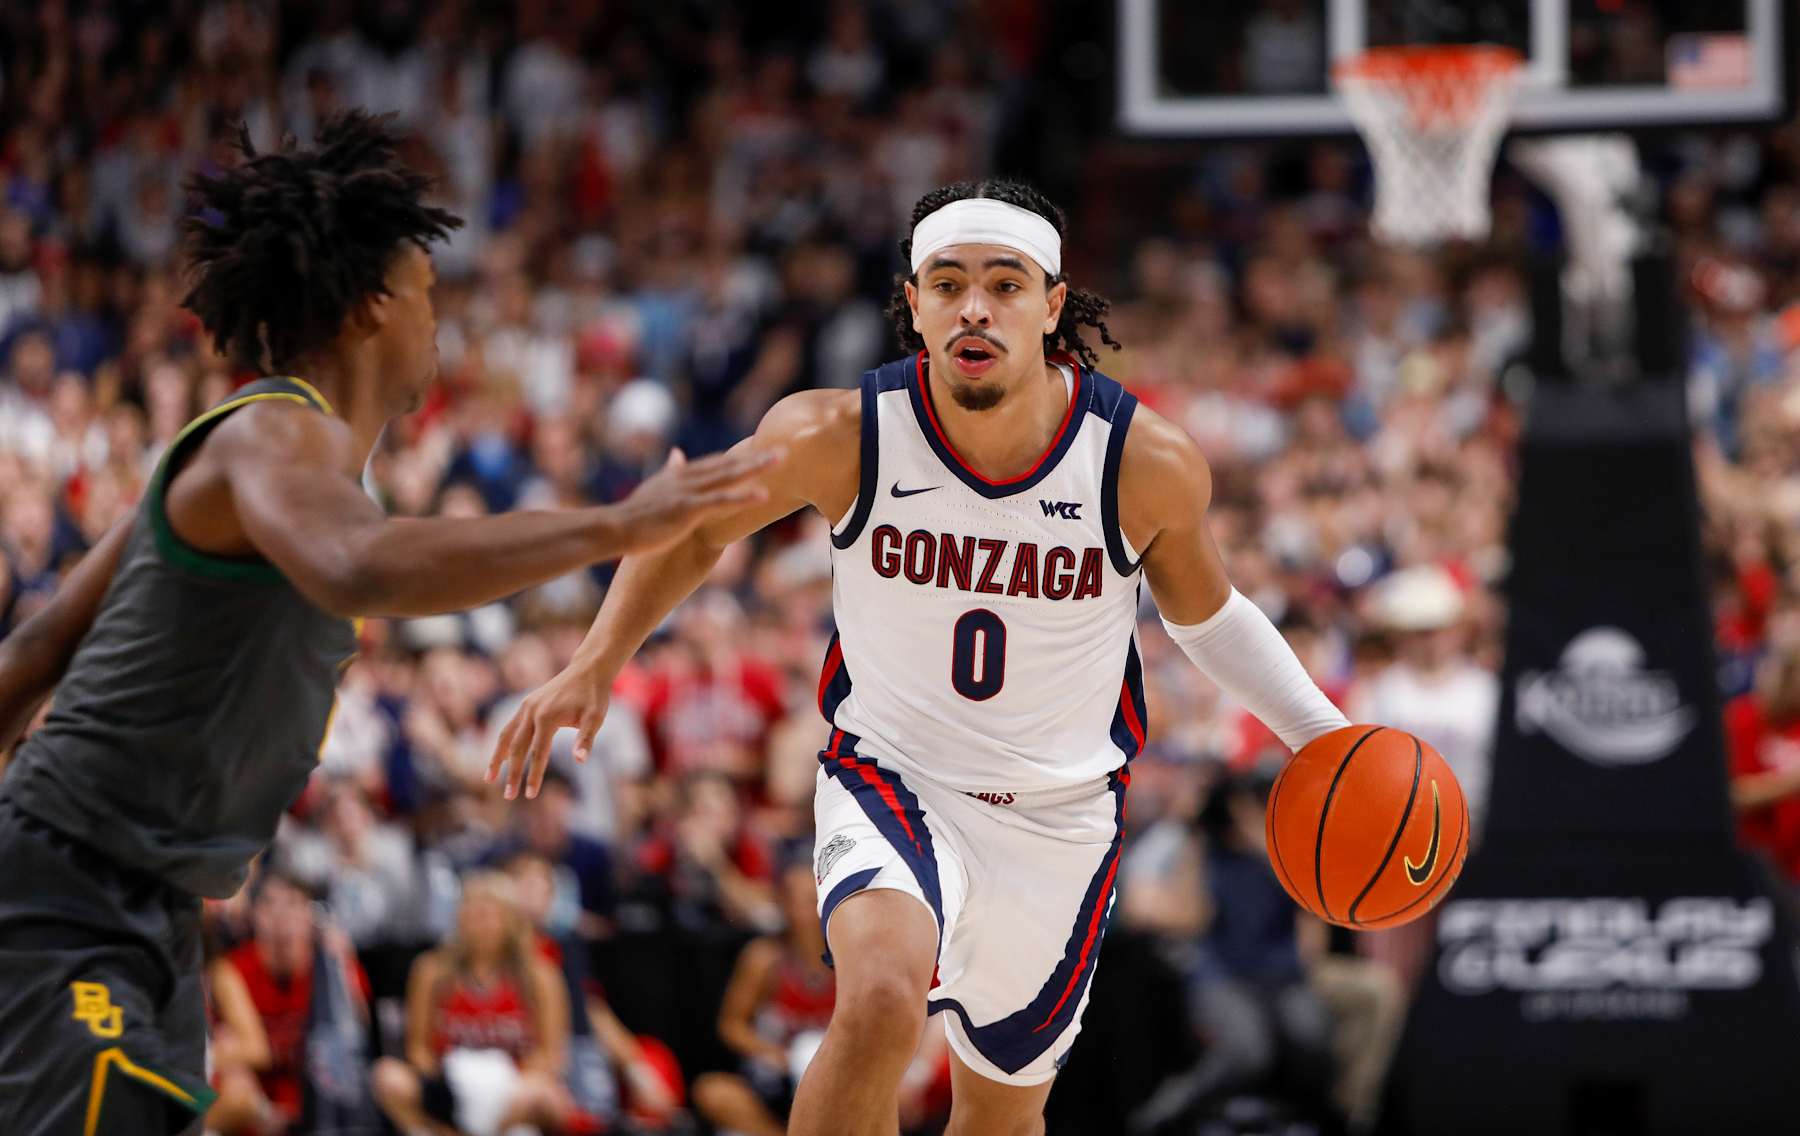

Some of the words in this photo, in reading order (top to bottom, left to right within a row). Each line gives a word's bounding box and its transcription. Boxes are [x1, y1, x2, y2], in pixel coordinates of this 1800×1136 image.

[1039, 500, 1083, 520] WCC
[871, 524, 1103, 600] GONZAGA
[951, 608, 1007, 701] 0
[70, 980, 124, 1038] BU
